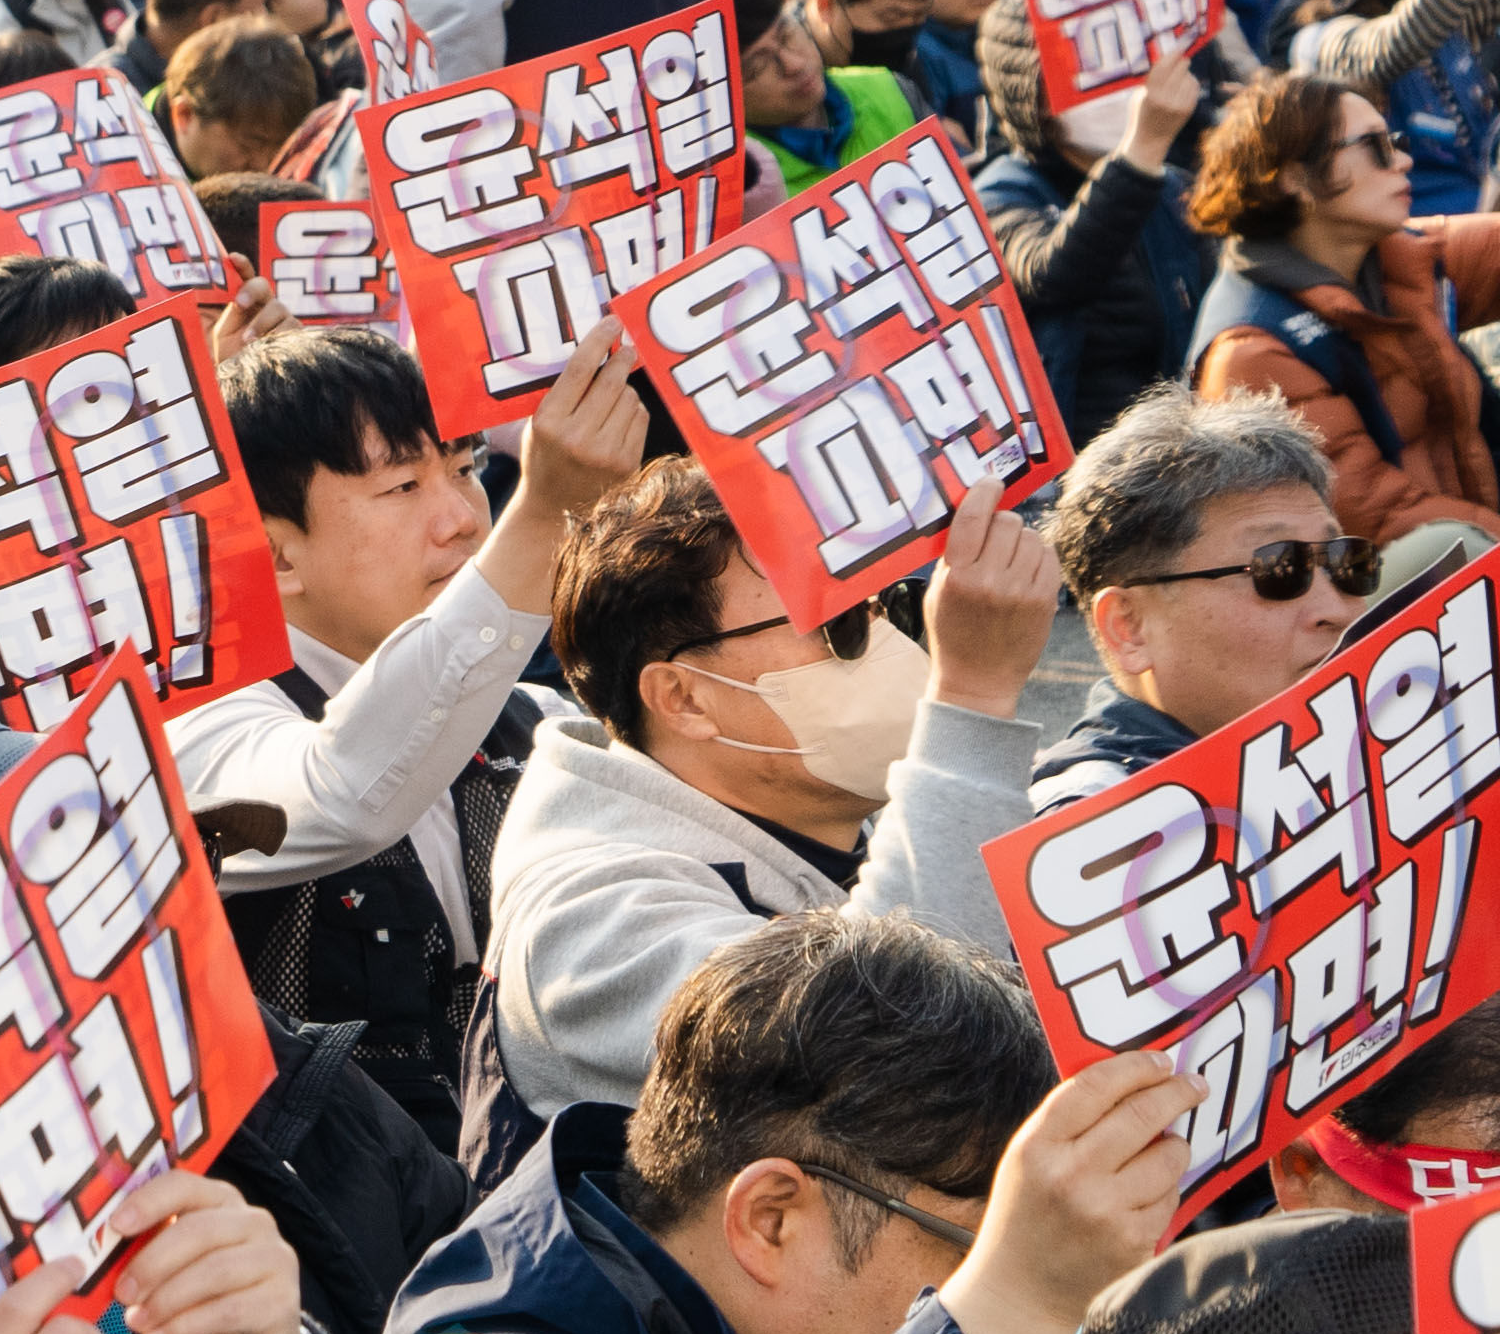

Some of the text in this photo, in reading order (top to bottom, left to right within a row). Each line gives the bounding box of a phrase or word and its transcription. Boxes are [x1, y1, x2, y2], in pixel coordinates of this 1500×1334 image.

[386, 9, 734, 257] 윤석열
[648, 135, 1005, 437] 윤석열
[757, 304, 1048, 582] 파면!
[1030, 577, 1500, 1049] 윤석열
